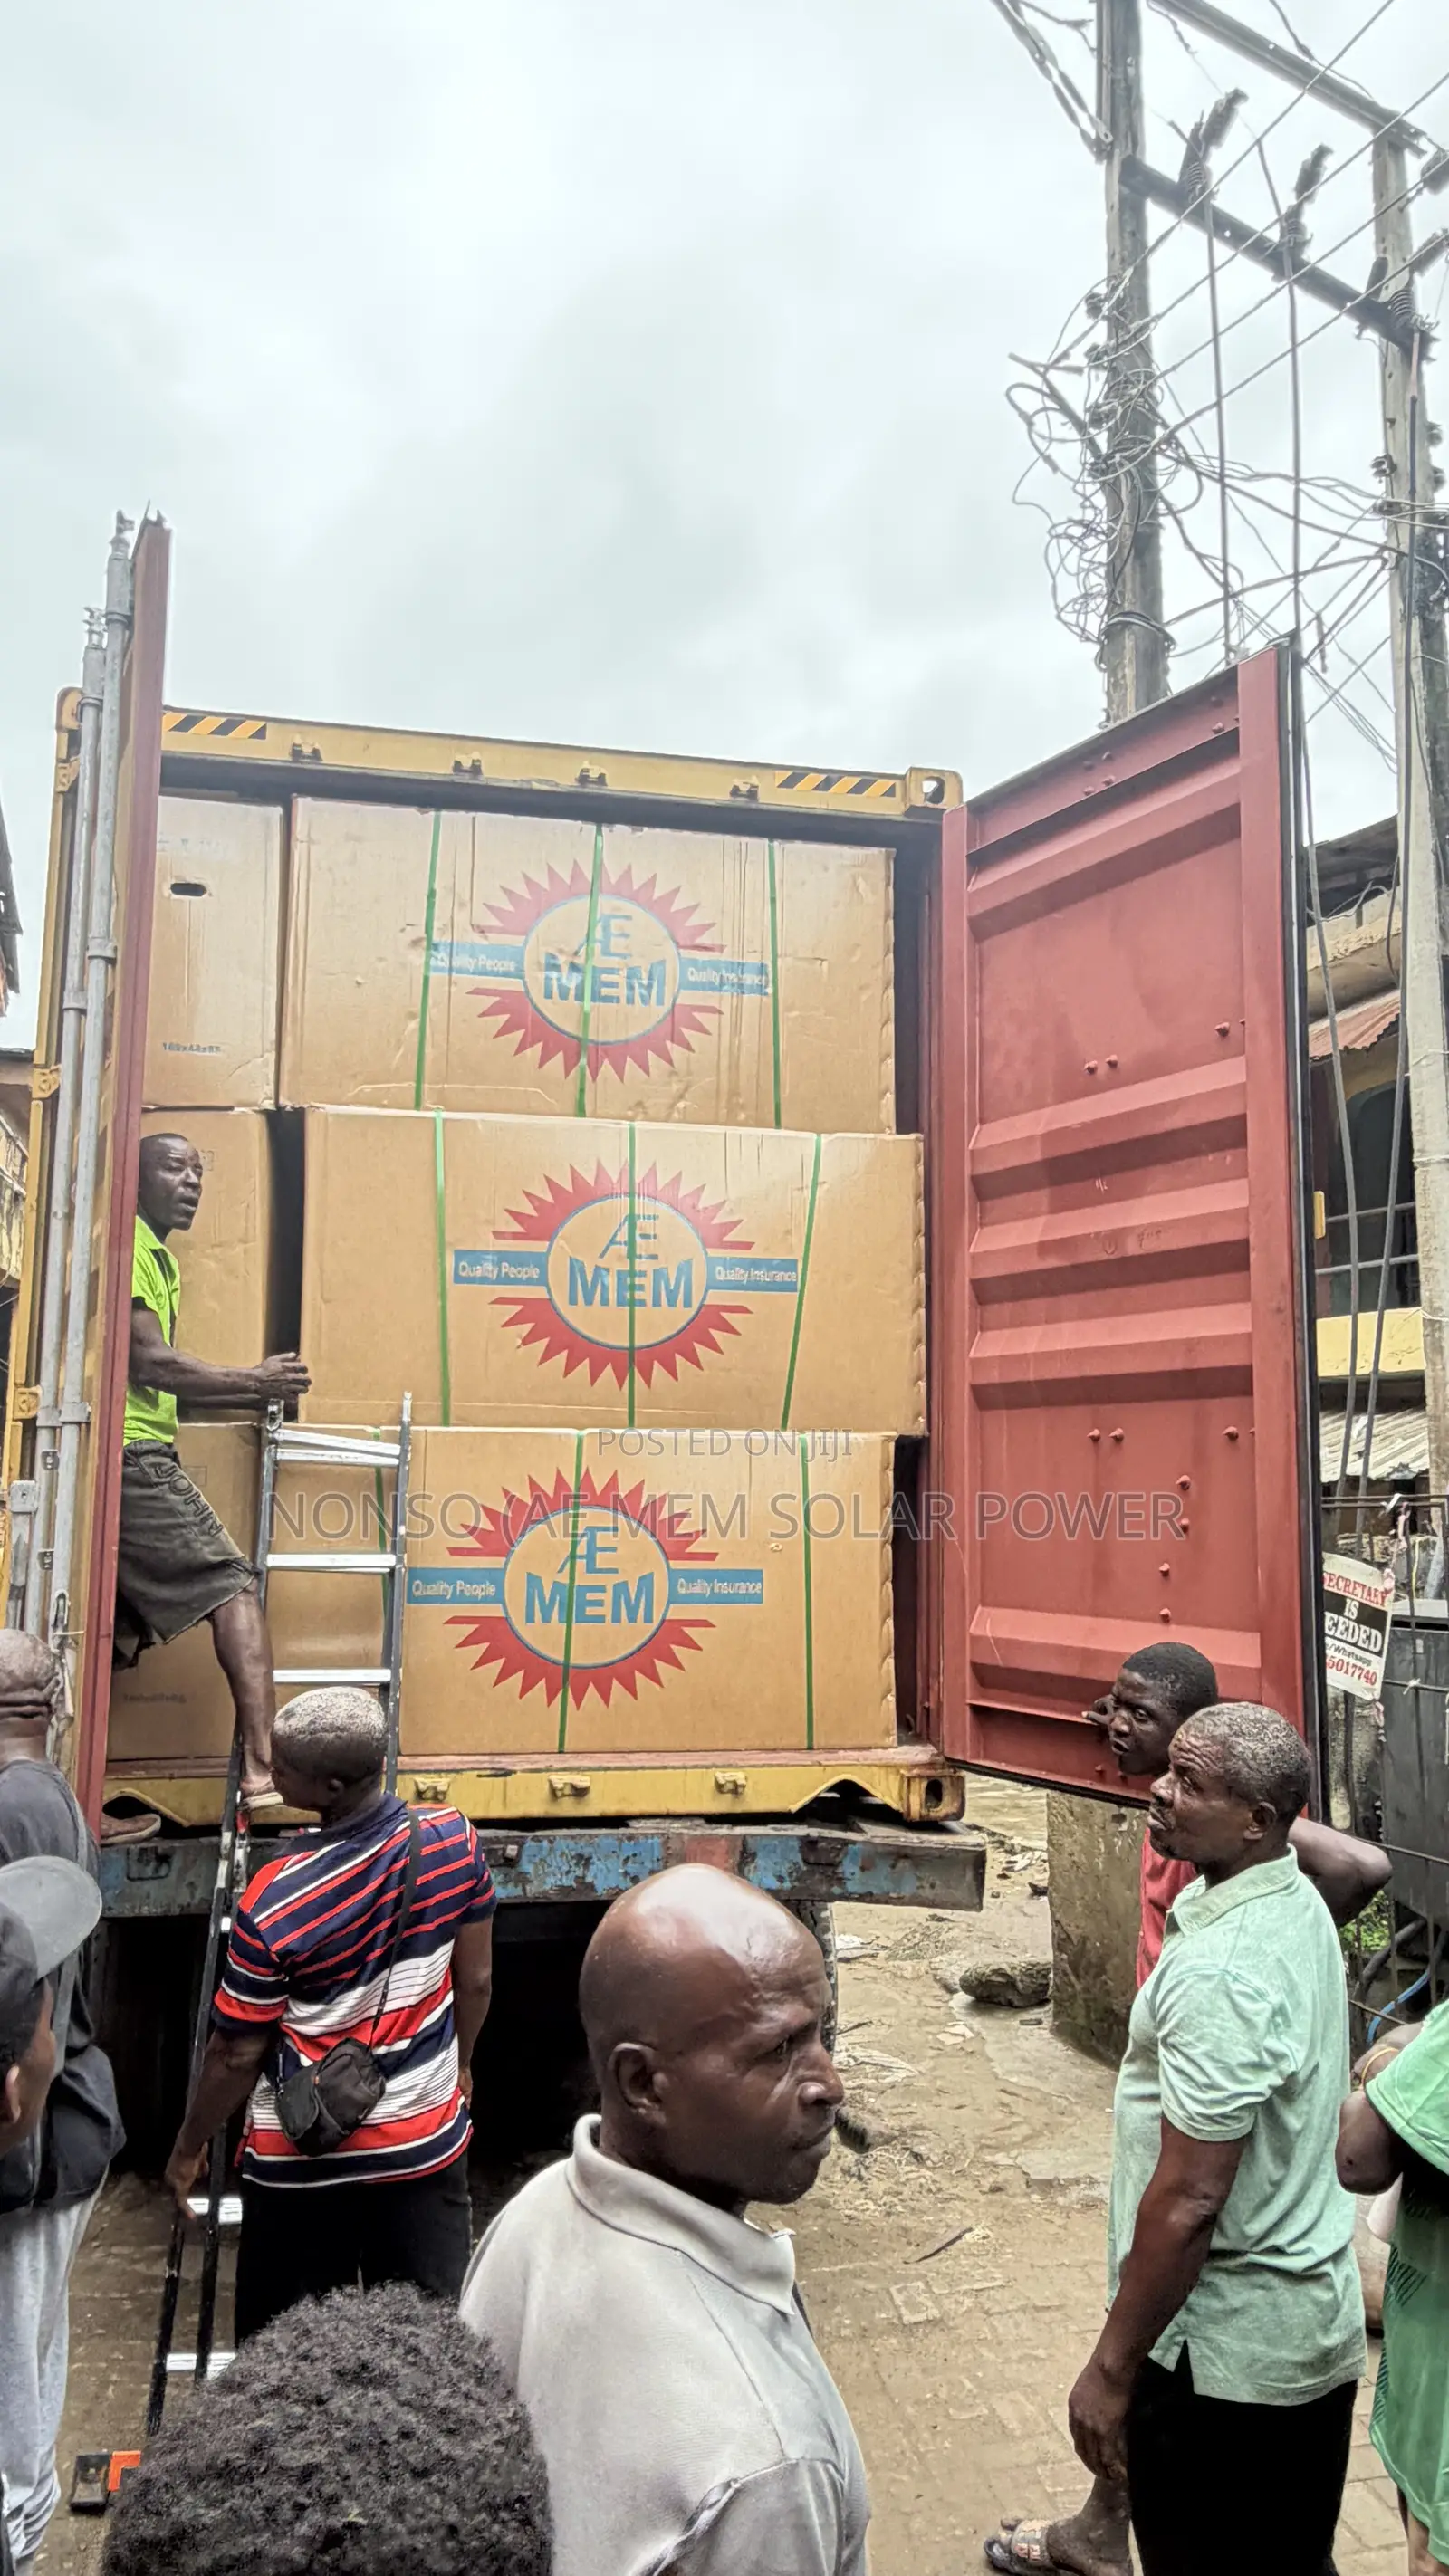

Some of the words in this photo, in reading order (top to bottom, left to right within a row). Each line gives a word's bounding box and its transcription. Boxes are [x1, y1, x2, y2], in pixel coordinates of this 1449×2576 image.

[543, 952, 667, 1008] MEM
[458, 1260, 499, 1280] Quality
[501, 1261, 540, 1280] People
[569, 1255, 694, 1309] MEM
[715, 1266, 749, 1284] Quality
[412, 1580, 455, 1600] Quality
[456, 1579, 496, 1601] People
[524, 1571, 655, 1623] MEM
[677, 1578, 711, 1598] Quality
[1343, 1598, 1359, 1621] IS
[1325, 1612, 1382, 1652] EEDED
[1326, 1655, 1377, 1686] 5017740
